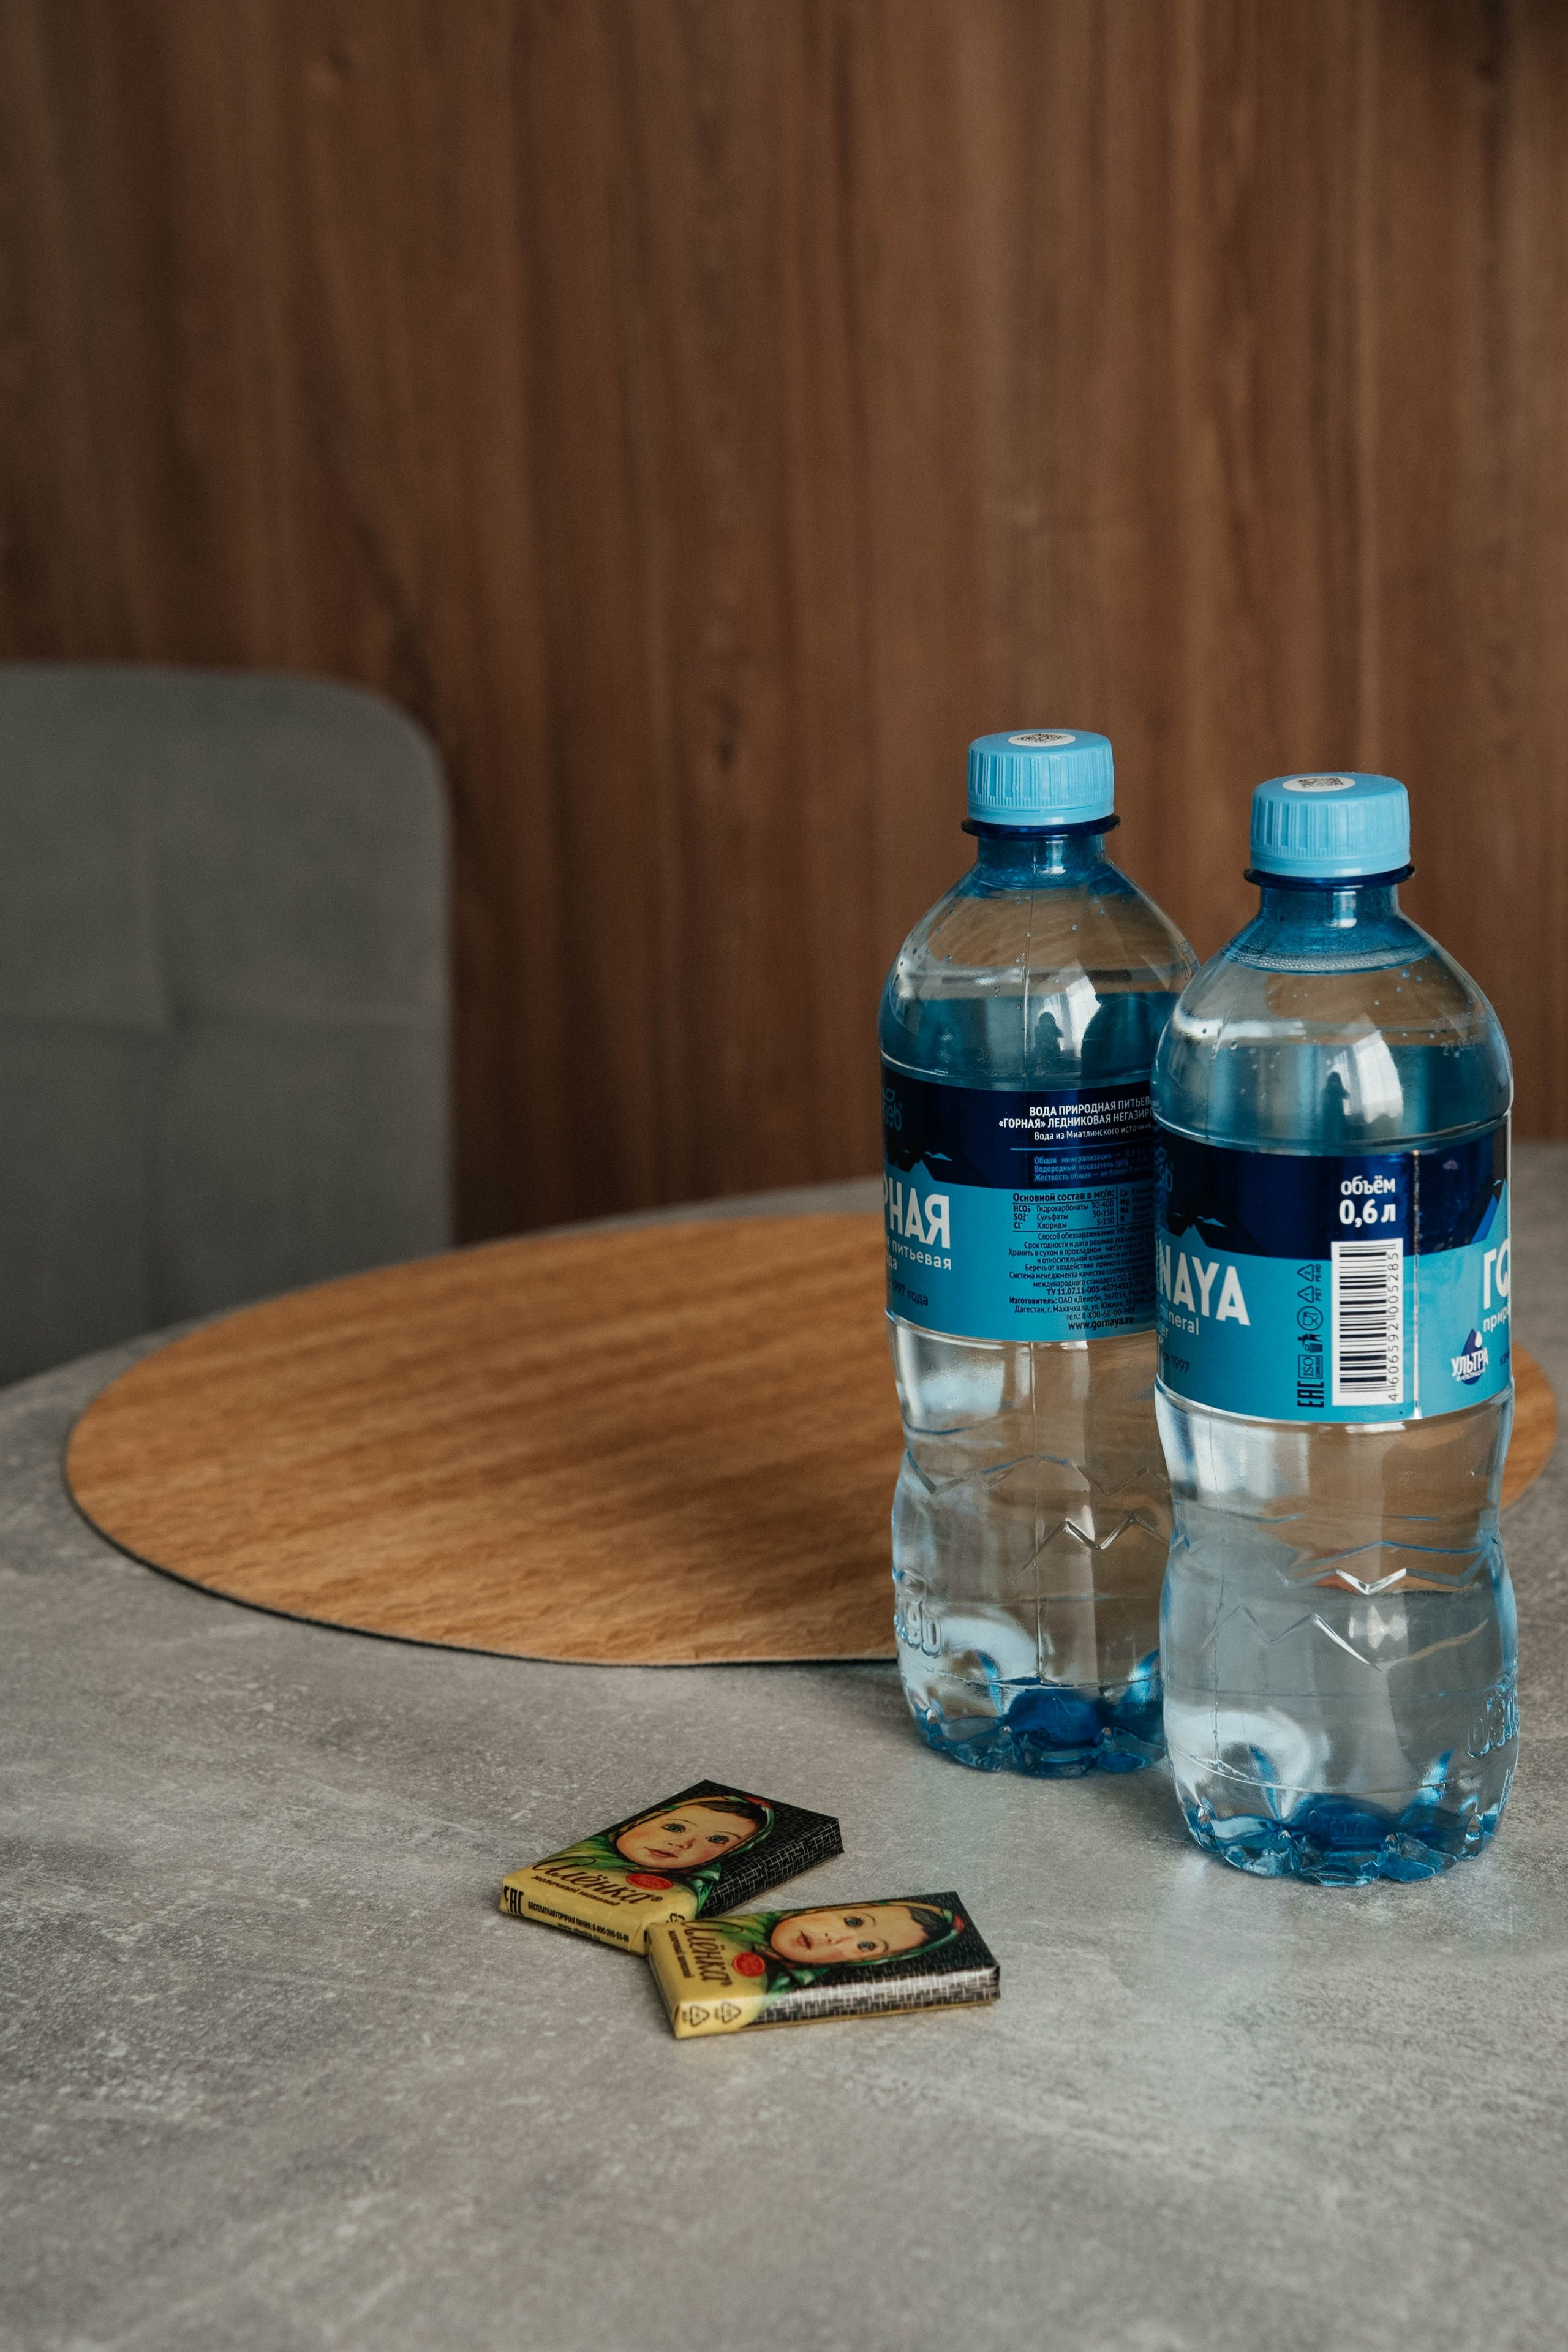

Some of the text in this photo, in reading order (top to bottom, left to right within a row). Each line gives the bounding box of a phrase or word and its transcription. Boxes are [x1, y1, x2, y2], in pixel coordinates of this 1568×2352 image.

[1030, 1096, 1150, 1117] ВОДА ПРИРОДНАЯ ПИТЬЕВ
[999, 1118, 1046, 1128] «ГОРНАЯ»
[1048, 1114, 1111, 1128] ЛЕДНИКОВАЯ
[1035, 1131, 1054, 1141] Вода
[1066, 1127, 1119, 1139] Миатлинского
[1035, 1156, 1057, 1165] Общая
[1061, 1152, 1112, 1163] минерализация
[1035, 1164, 1076, 1174] Водородный
[1078, 1161, 1114, 1172] показатель
[1071, 1172, 1091, 1180] общая
[1340, 1175, 1395, 1196] объём
[1012, 1192, 1055, 1202] Основной
[1058, 1191, 1085, 1200] состав
[1036, 1203, 1088, 1213] Гидрокарбонаты
[1091, 1200, 1114, 1209] 30-400
[1036, 1213, 1068, 1223] Сульфаты
[1339, 1199, 1396, 1228] 0,6 л
[1037, 1222, 1067, 1231] Хлориды
[1096, 1216, 1115, 1226] 5-150
[1038, 1232, 1060, 1242] Способ
[1041, 1240, 1068, 1250] годности
[1075, 1240, 1088, 1248] дата
[1089, 1238, 1113, 1248] розлива
[892, 1240, 952, 1270] питьевая
[1008, 1248, 1033, 1257] Хранить
[1039, 1248, 1058, 1257] сухом
[1065, 1245, 1101, 1256] прохладном
[1042, 1254, 1087, 1264] относительной
[1025, 1264, 1047, 1273] Беречь
[1056, 1262, 1094, 1272] воздействия
[1096, 1259, 1120, 1268] прямого
[1009, 1270, 1035, 1280] Система
[1036, 1270, 1078, 1280] менеджмента
[1079, 1268, 1105, 1278] качества
[1033, 1278, 1085, 1289] международного
[1087, 1276, 1116, 1286] стандарта
[1159, 1238, 1251, 1326] NAYA
[907, 1289, 929, 1306] года
[1009, 1296, 1057, 1305] Изготовитель:
[1014, 1305, 1046, 1314] Дагестан,
[1053, 1303, 1091, 1313] Махачкала,
[1068, 1317, 1134, 1330] www.gornaya.ru
[1483, 1306, 1509, 1333] прир
[1303, 1357, 1314, 1376] ISO
[1451, 1347, 1489, 1377] УЛЬТРА
[531, 1875, 579, 1894] молочный
[532, 1856, 655, 1904] Алёнка
[527, 1901, 556, 1918] БЕСПЛАТНАЯ
[556, 1910, 575, 1923] ГОРЯЧАЯ
